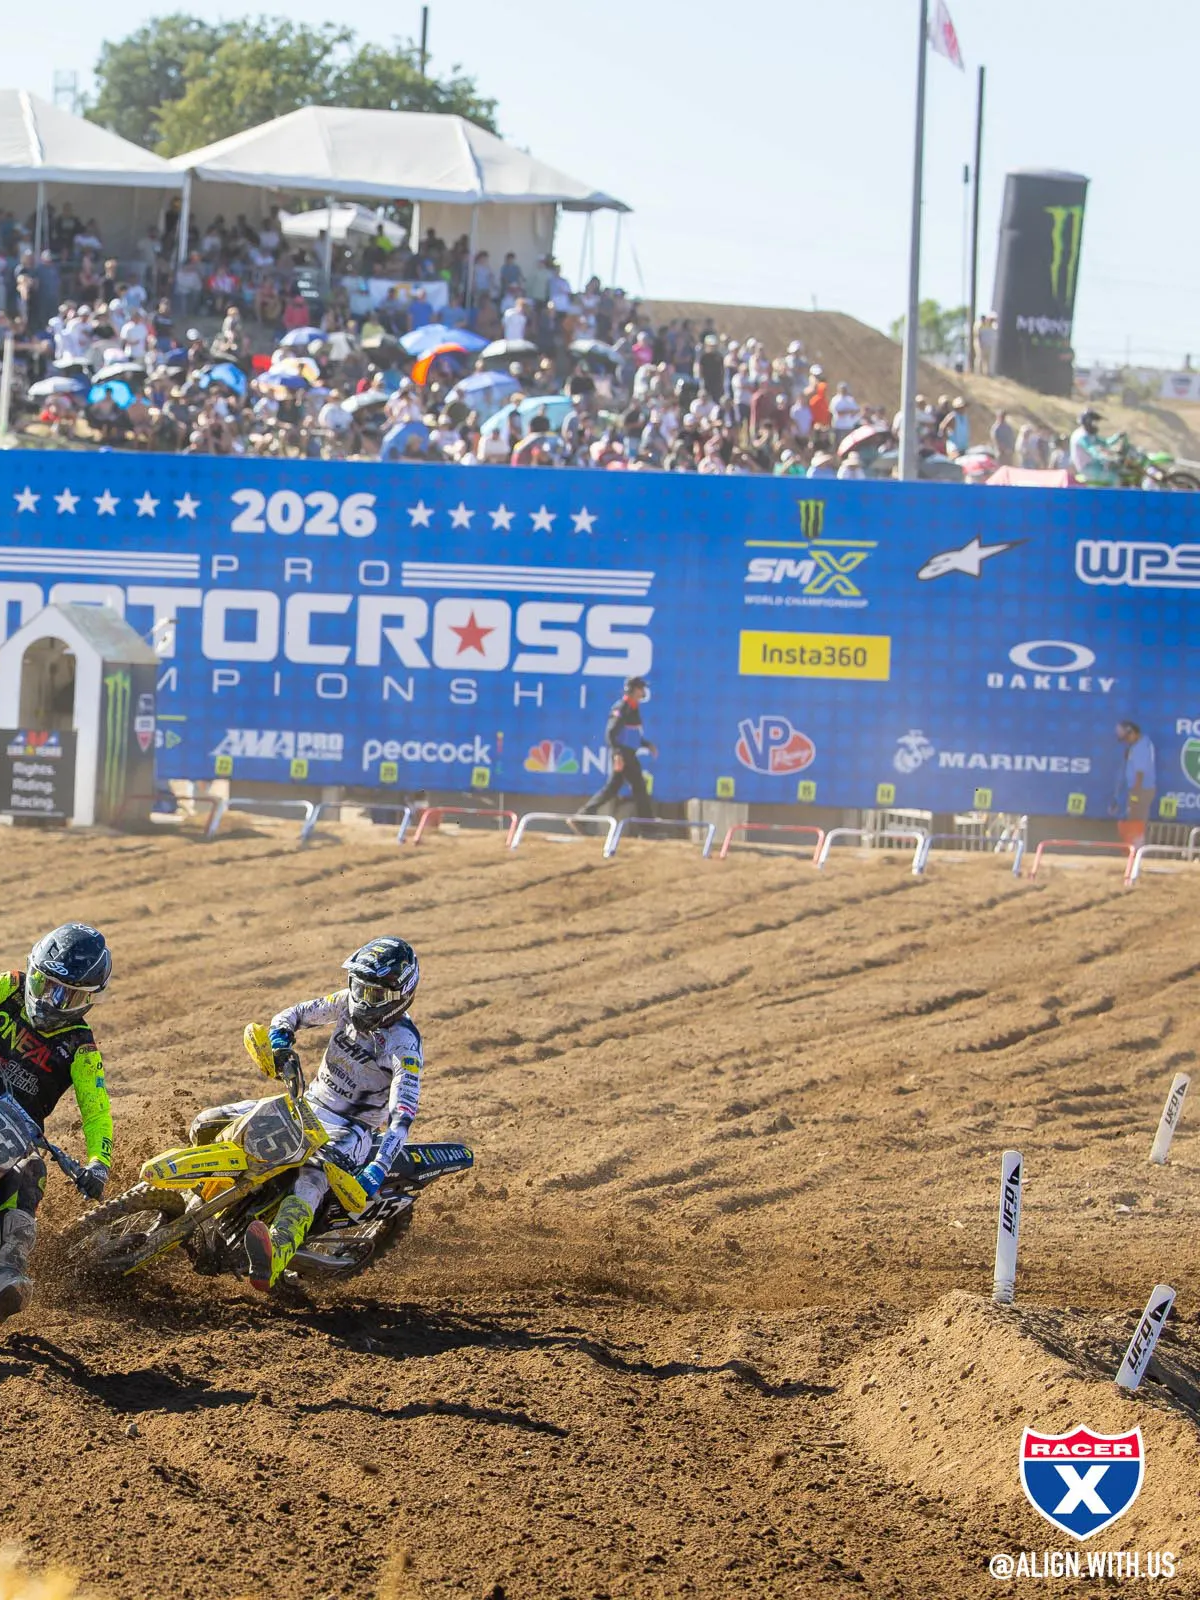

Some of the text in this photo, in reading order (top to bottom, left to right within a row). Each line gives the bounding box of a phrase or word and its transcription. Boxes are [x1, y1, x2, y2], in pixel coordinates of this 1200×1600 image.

[230, 489, 378, 537] 2026
[211, 555, 390, 587] PRO
[744, 550, 870, 596] SMX
[761, 643, 868, 668] Insta360
[987, 672, 1116, 693] OAKLEY
[210, 728, 295, 760] AMA
[362, 735, 491, 772] peacock
[738, 716, 792, 772] VP
[938, 752, 1091, 774] MARINES
[333, 1030, 376, 1065] LEATT
[320, 1072, 354, 1100] SUZUKI
[1165, 1093, 1179, 1126] UFO
[251, 1115, 288, 1162] 45
[1001, 1187, 1015, 1234] UFO
[1127, 1317, 1154, 1372] UFO
